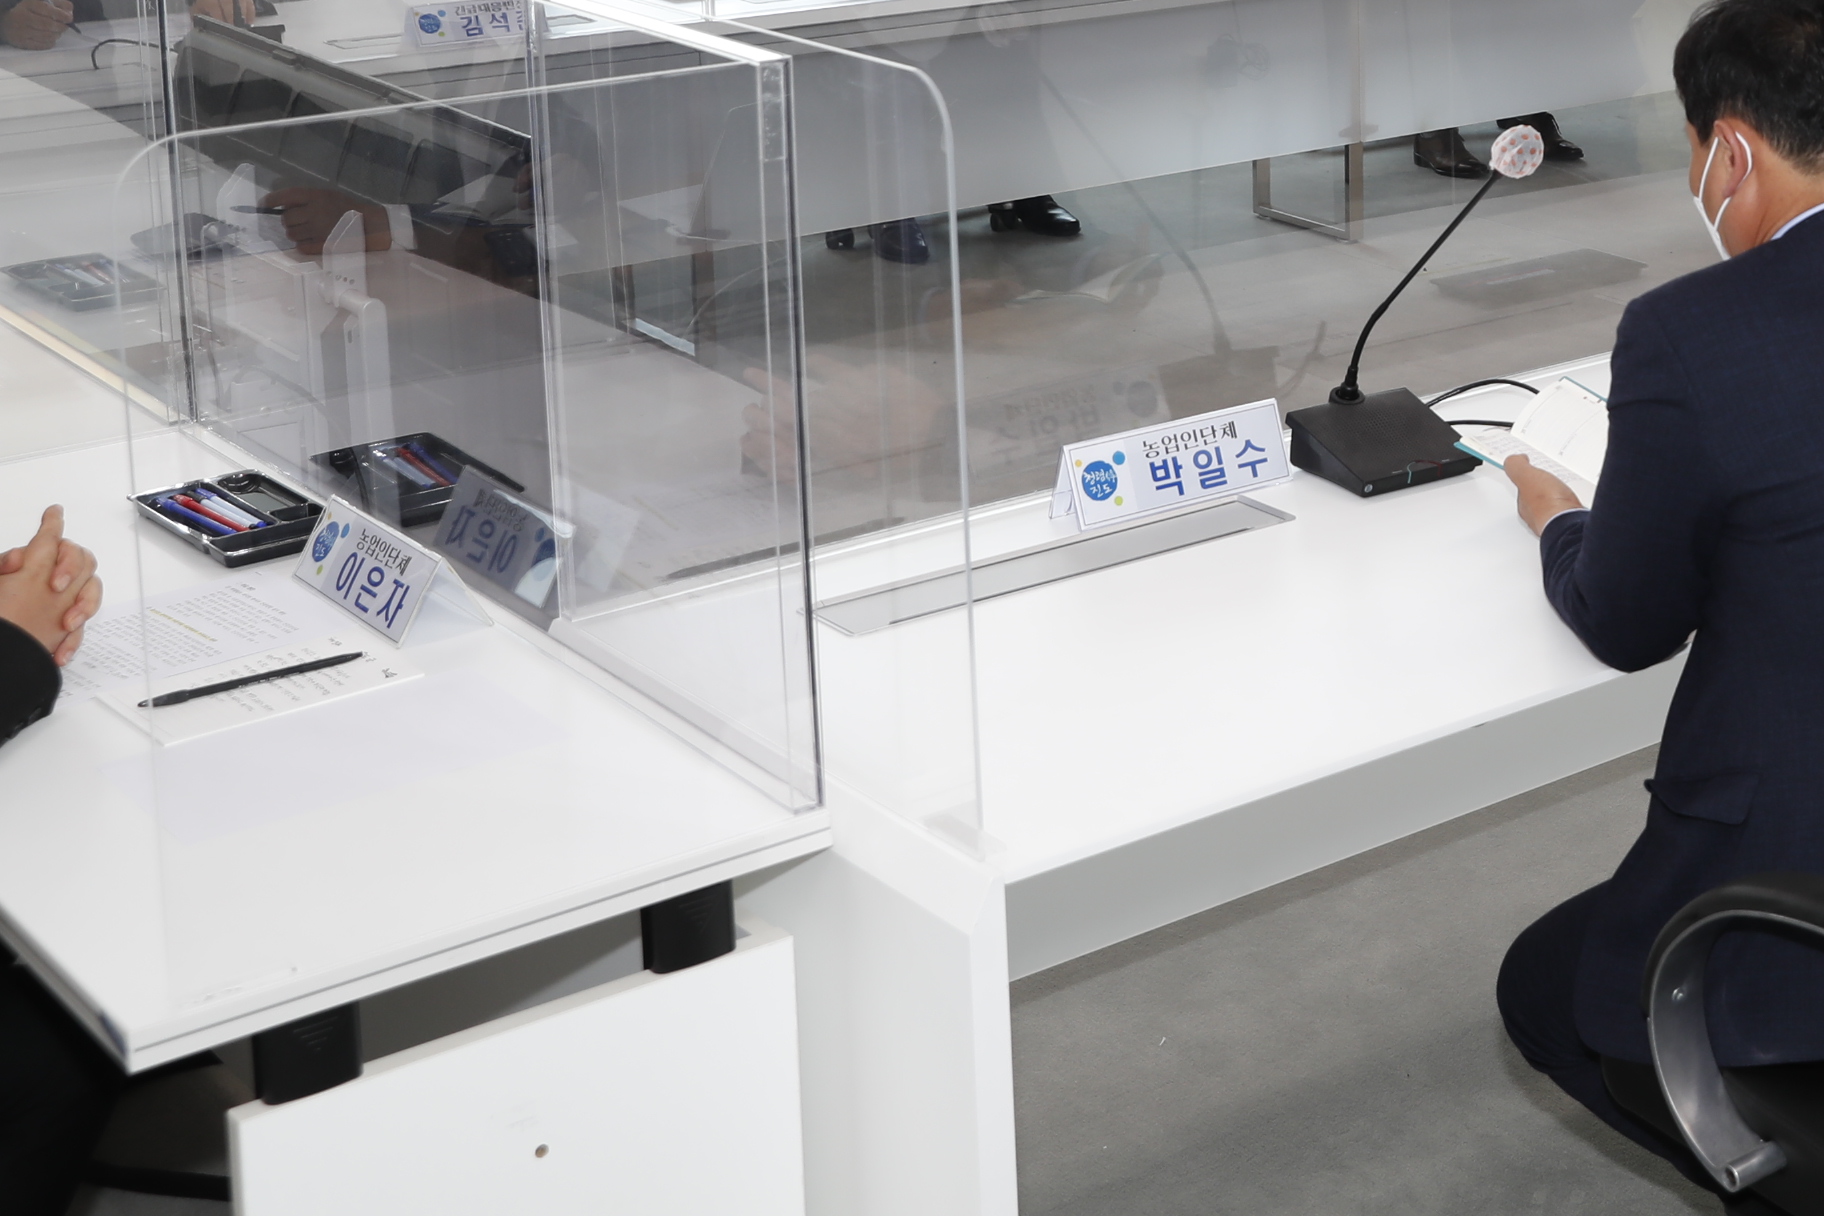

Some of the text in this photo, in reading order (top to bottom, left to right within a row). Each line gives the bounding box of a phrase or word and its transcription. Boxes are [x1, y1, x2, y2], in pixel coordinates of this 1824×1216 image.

[1143, 421, 1238, 459] 농업인단체
[1089, 483, 1113, 498] 진도
[1149, 439, 1268, 496] 박일수
[357, 528, 412, 576] 농업인단체
[336, 551, 410, 629] 이은자
